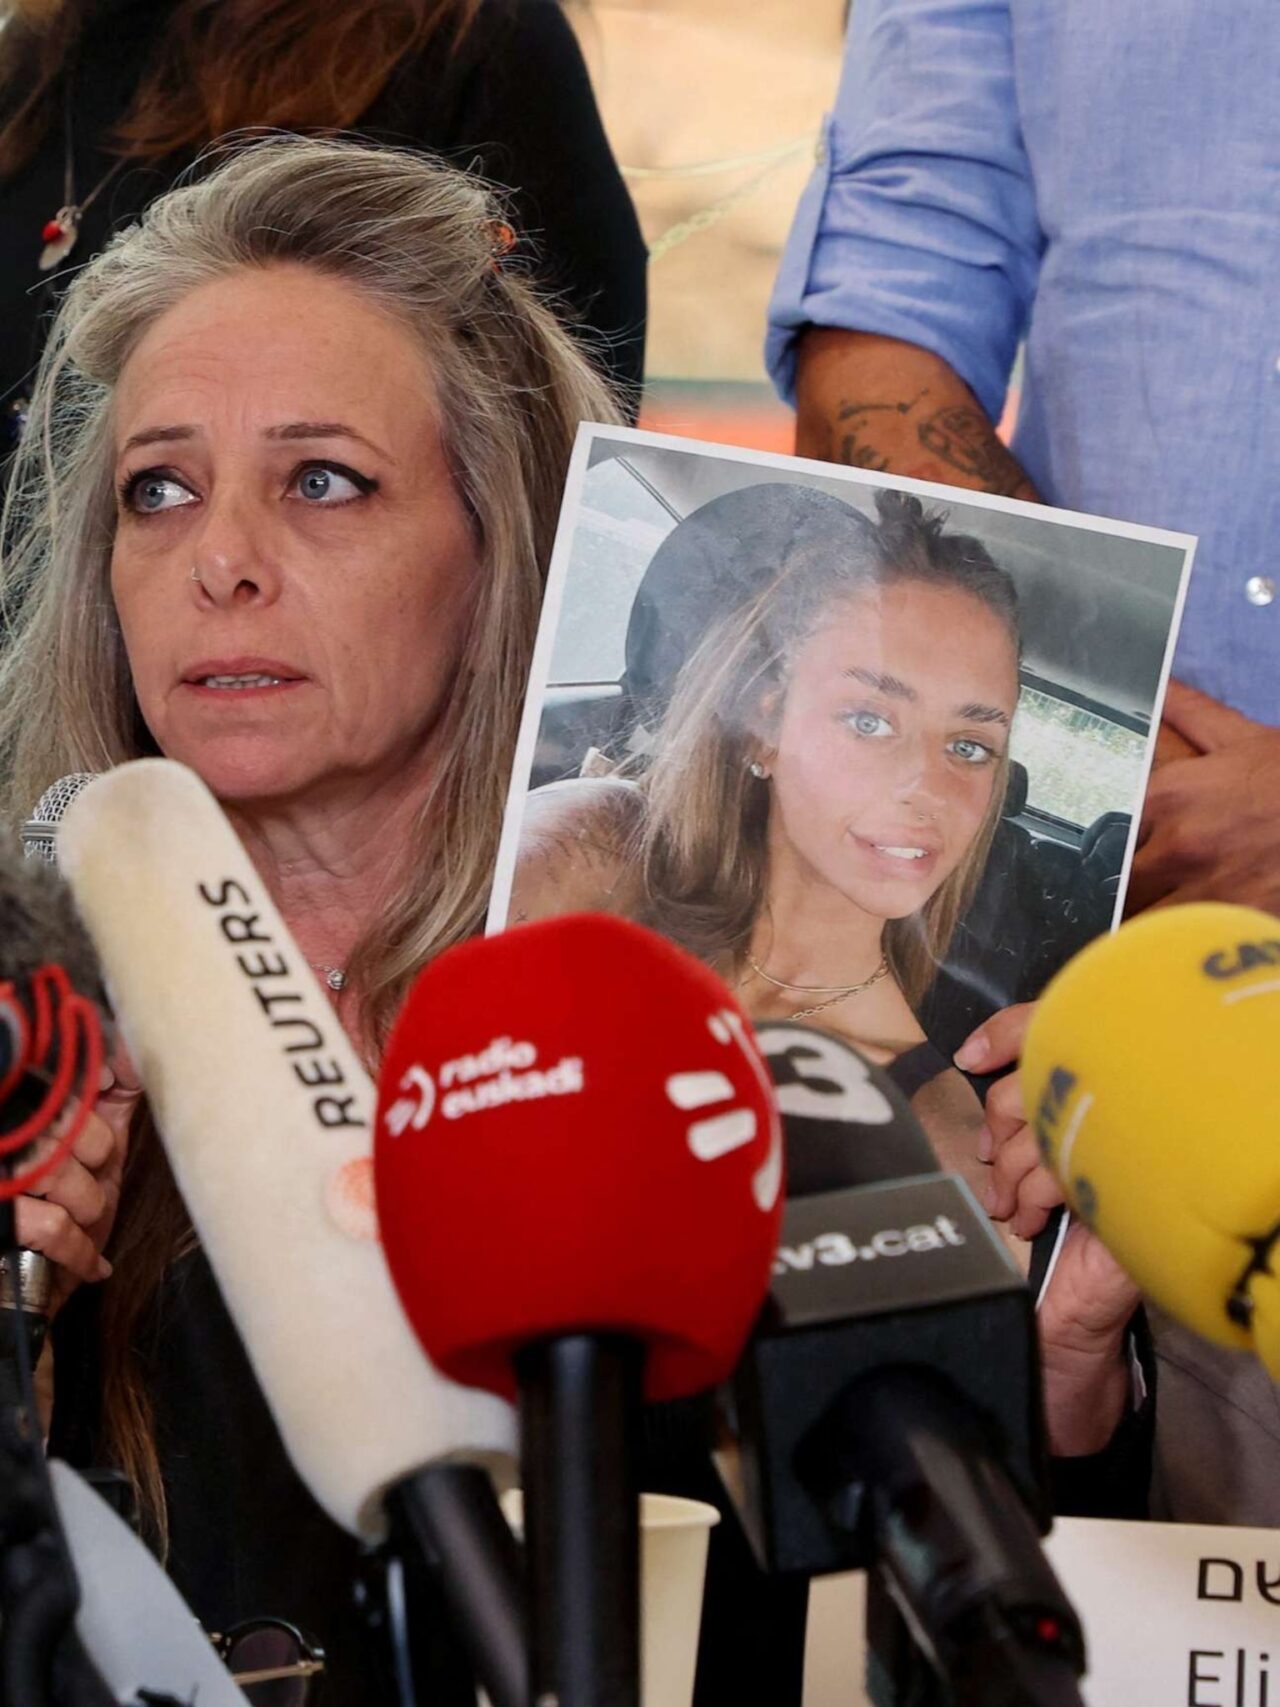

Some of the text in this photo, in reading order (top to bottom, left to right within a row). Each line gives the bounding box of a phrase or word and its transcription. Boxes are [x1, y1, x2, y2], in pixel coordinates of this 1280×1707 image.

[197, 878, 366, 1130] REUTERS
[439, 1036, 537, 1089] radio
[441, 1057, 584, 1120] euskadi
